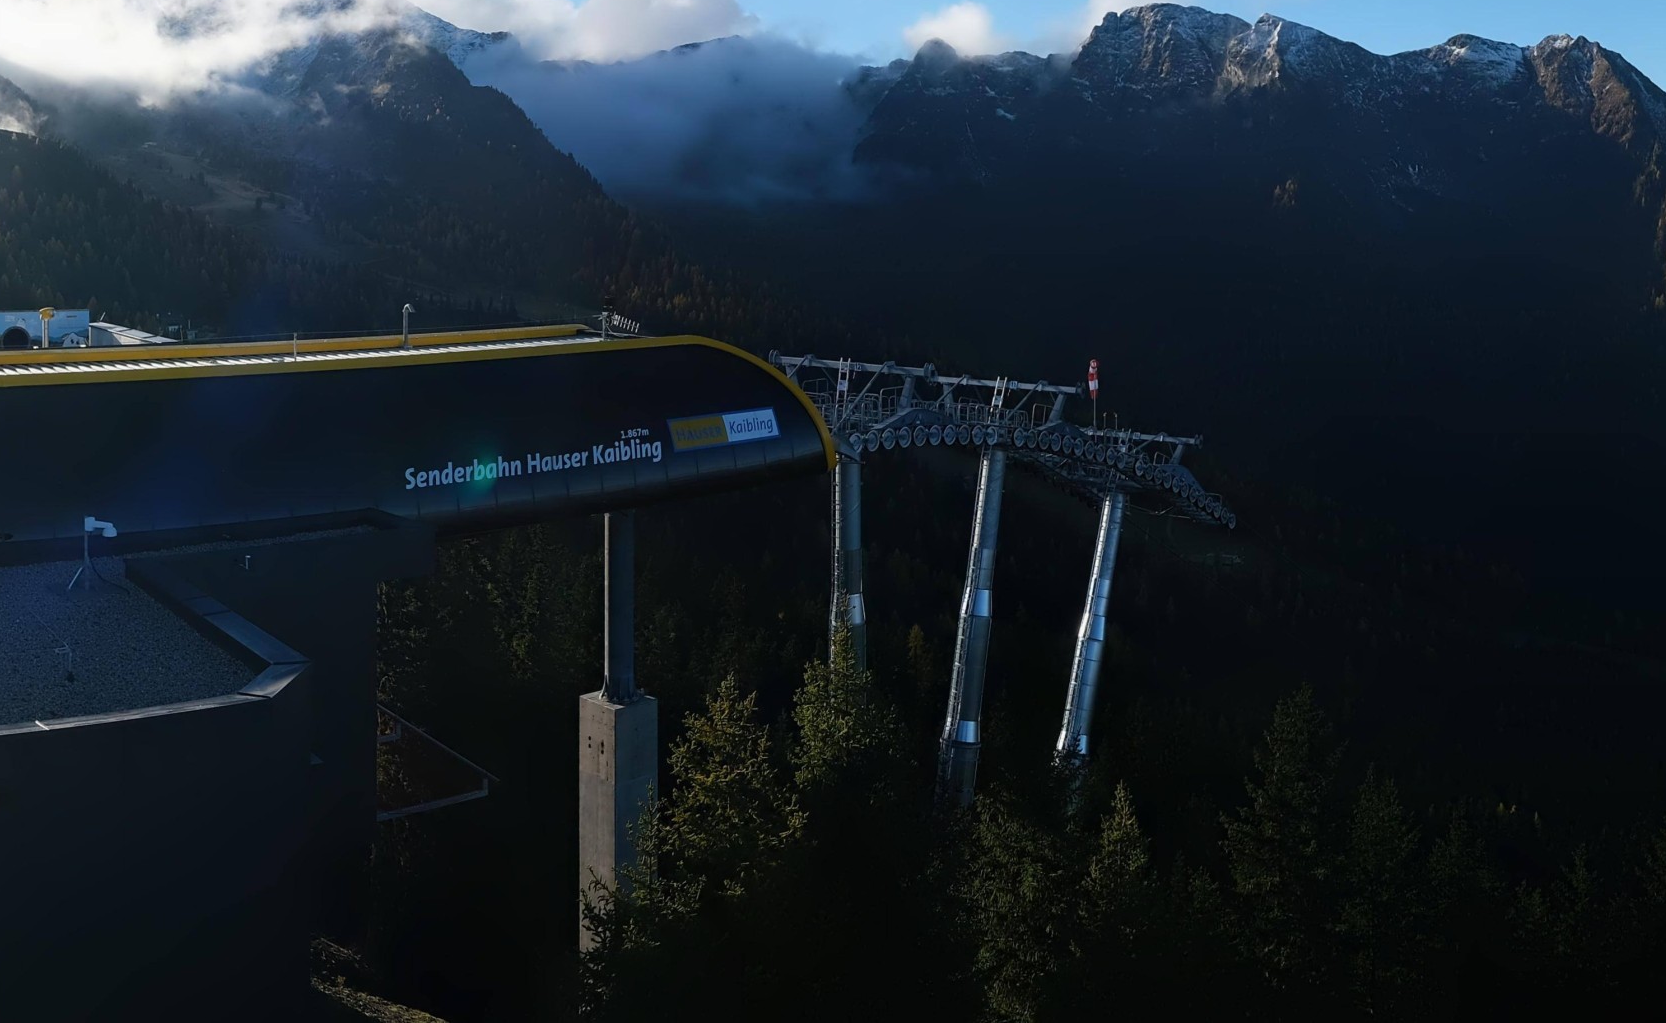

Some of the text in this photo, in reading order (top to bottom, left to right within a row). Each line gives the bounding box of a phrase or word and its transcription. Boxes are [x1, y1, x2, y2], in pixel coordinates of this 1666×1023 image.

[620, 428, 649, 439] 1.867m
[676, 417, 774, 441] HAUSER Kaibling
[404, 438, 663, 490] Senderbahn Hauser Kaibling
